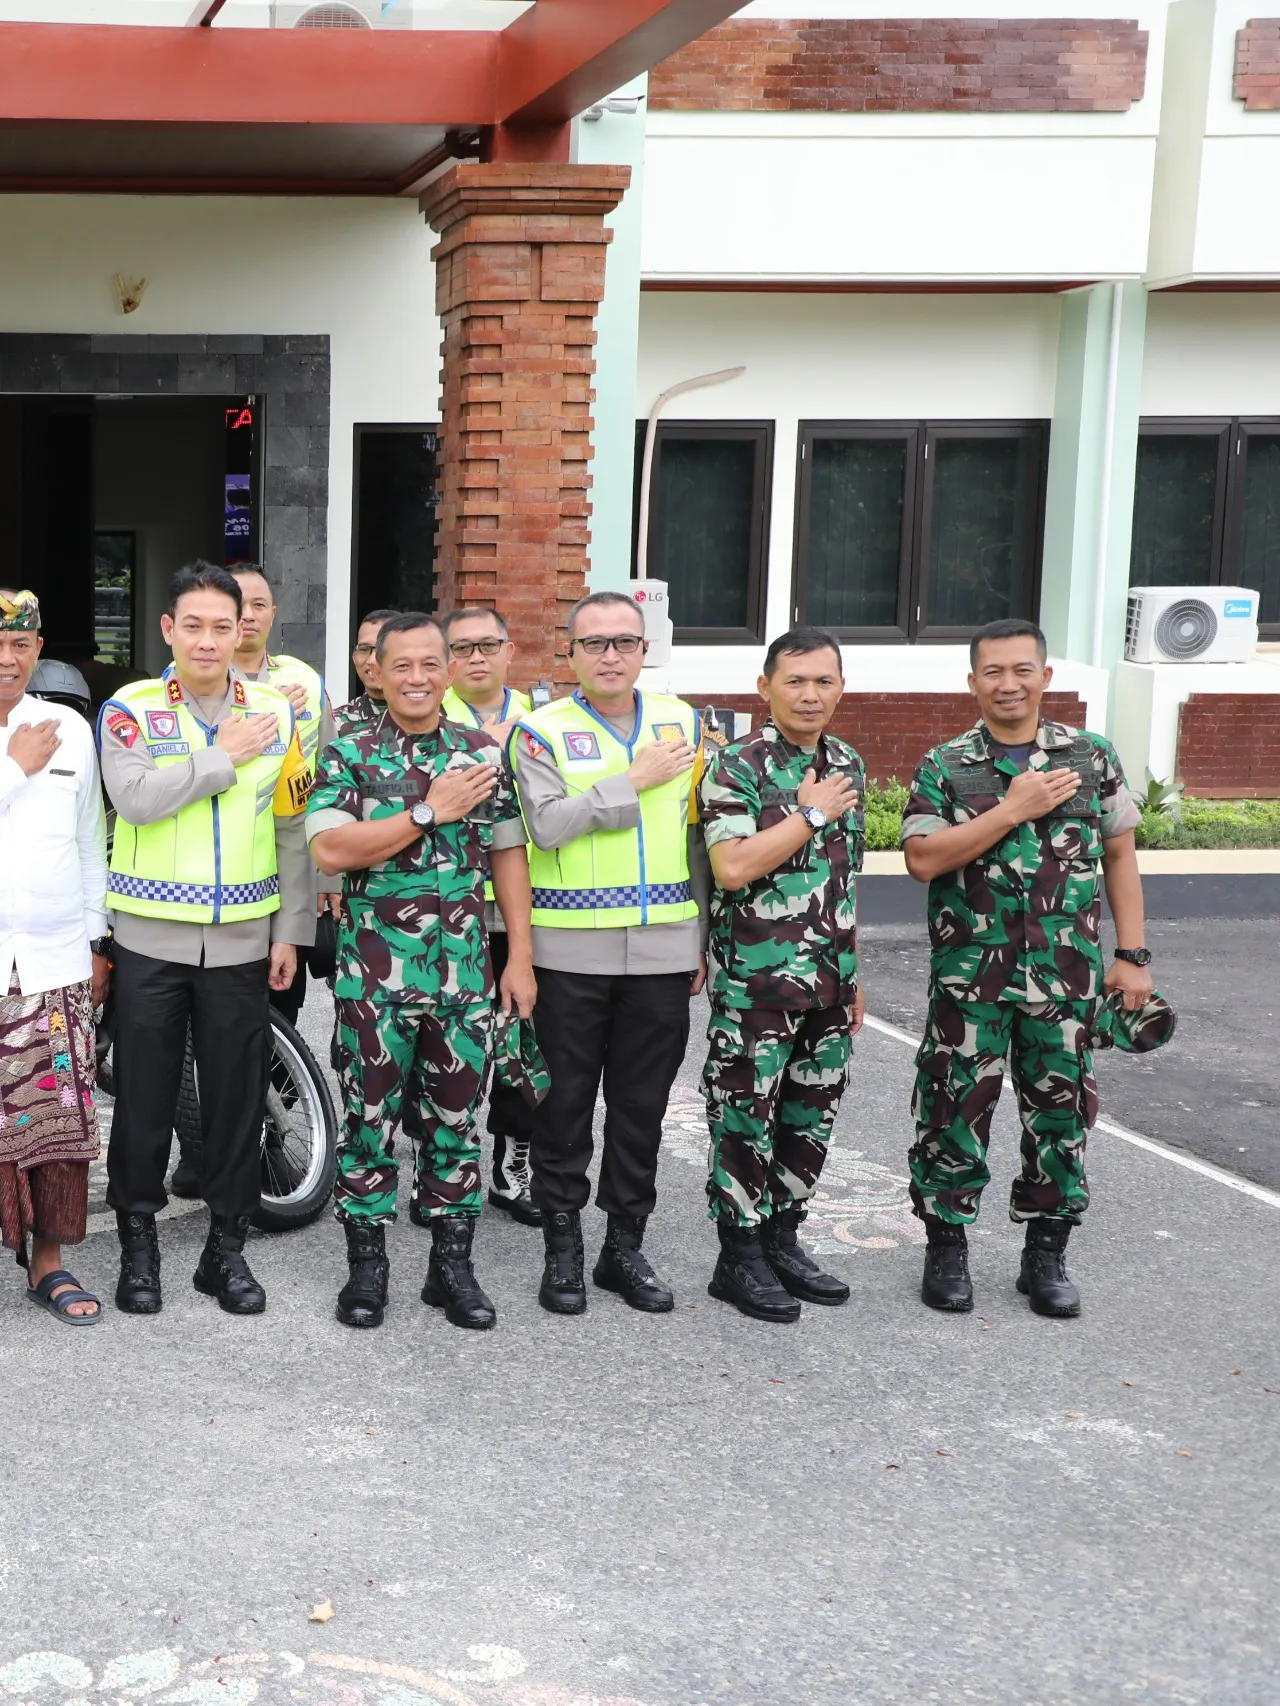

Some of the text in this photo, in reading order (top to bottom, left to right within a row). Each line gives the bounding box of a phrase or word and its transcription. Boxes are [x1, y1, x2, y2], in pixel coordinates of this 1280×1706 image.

[648, 592, 663, 602] LG
[151, 744, 179, 755] DANIEL
[265, 745, 286, 754] OLDA
